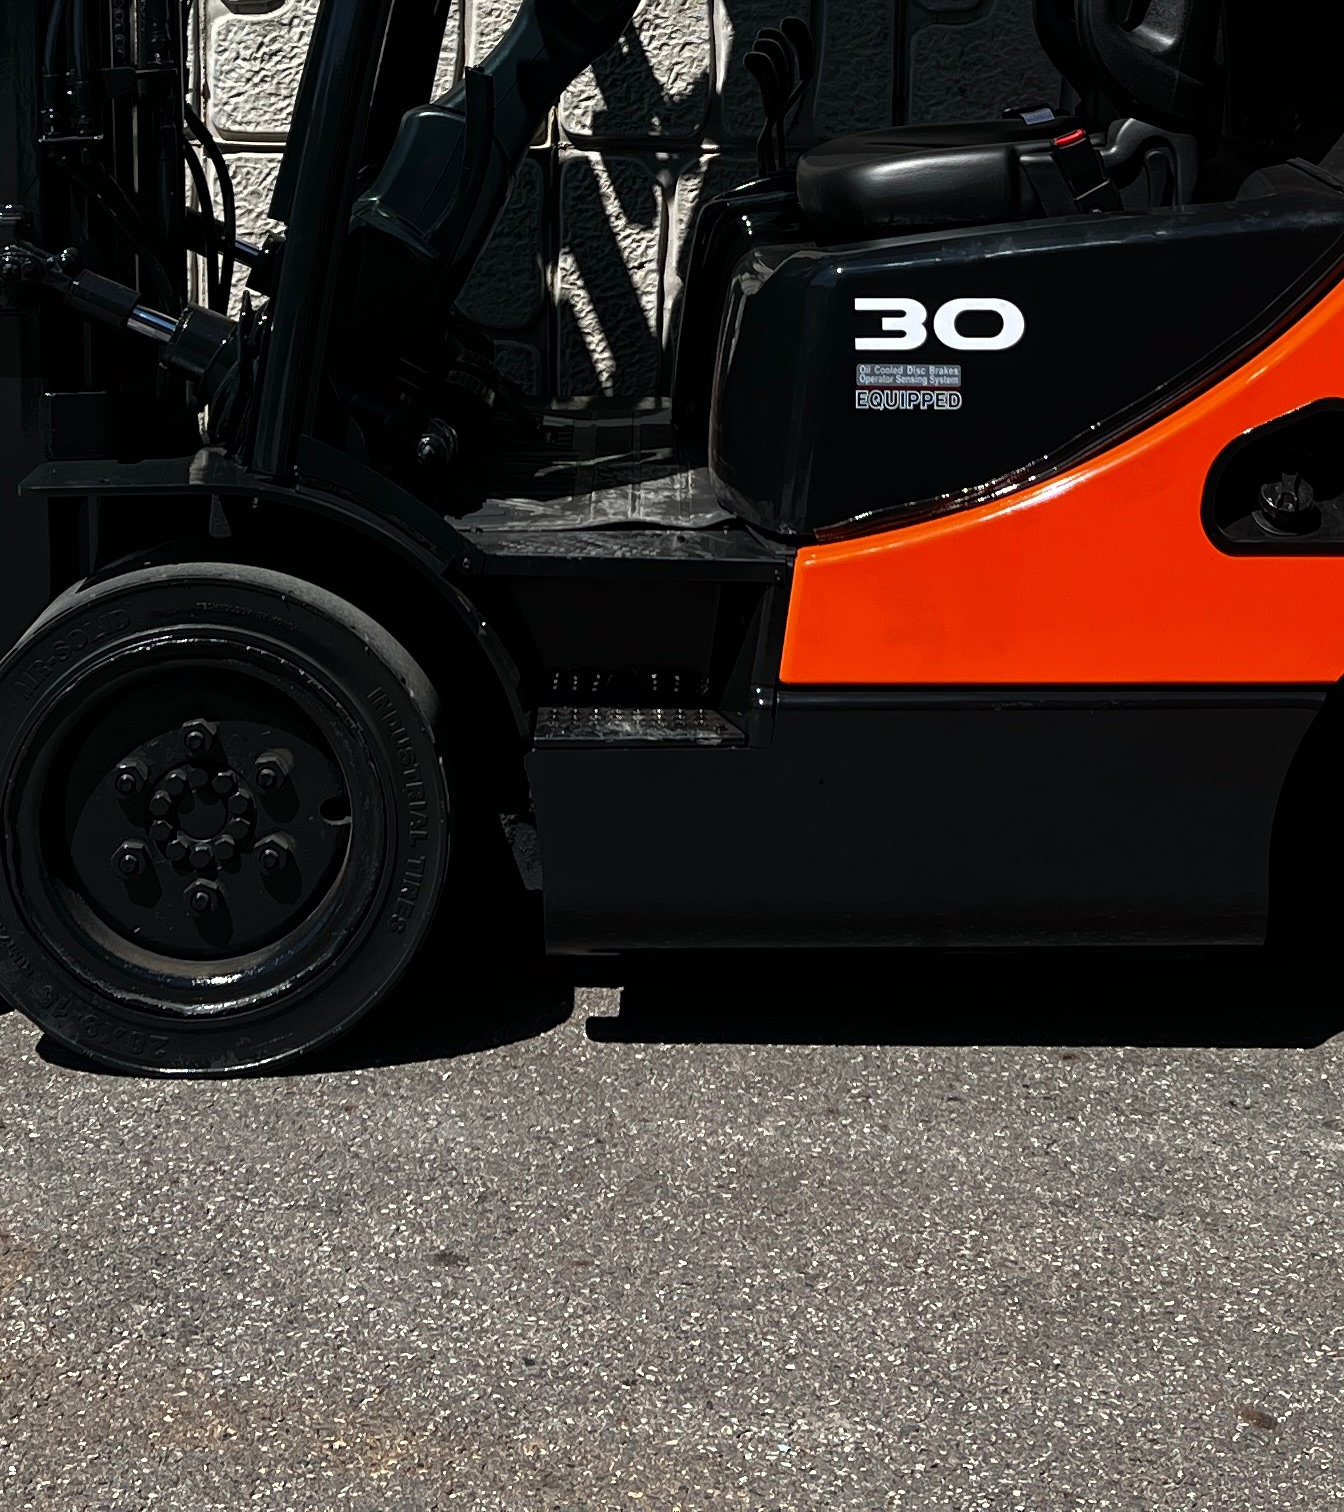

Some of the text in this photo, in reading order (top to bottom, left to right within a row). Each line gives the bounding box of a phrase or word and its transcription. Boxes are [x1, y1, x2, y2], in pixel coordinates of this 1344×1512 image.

[854, 297, 1025, 350] 30
[859, 365, 960, 375] Oil Cooled Disc Brakes
[859, 374, 959, 386] Operator Sensing System
[856, 390, 962, 410] EQUIPPED
[367, 686, 429, 935] INDUSTRIAL TIRES
